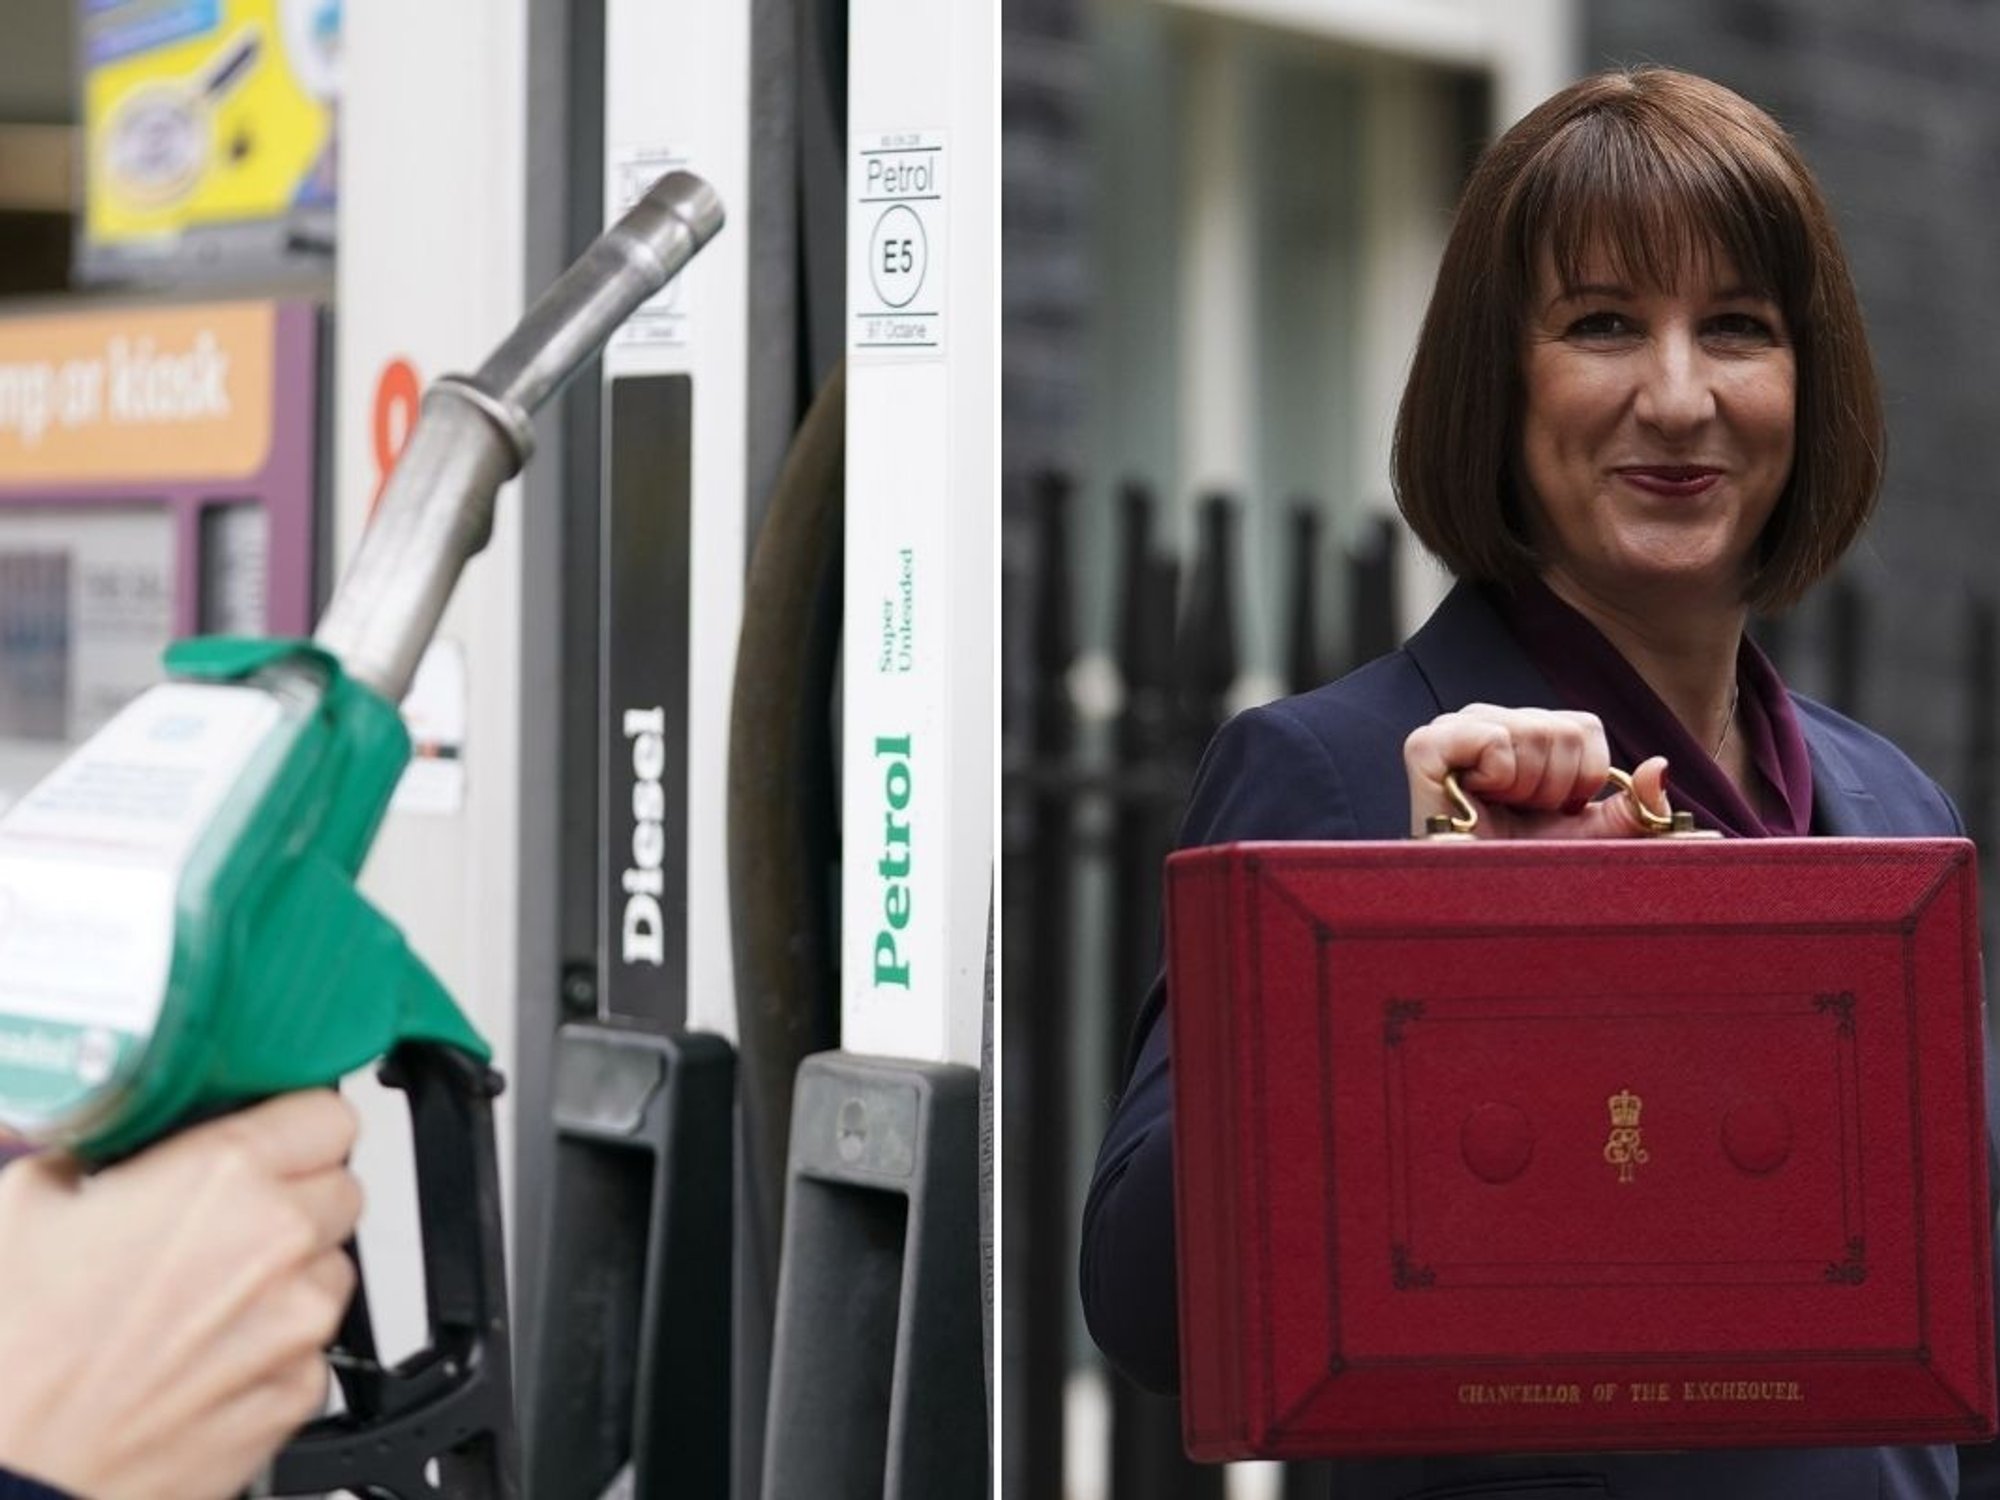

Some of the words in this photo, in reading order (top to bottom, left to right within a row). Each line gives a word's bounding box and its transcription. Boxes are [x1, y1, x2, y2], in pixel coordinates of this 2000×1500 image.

[867, 155, 934, 194] Petrol
[883, 239, 913, 274] E5
[106, 328, 231, 427] kiosk
[880, 599, 896, 673] Super
[898, 548, 913, 673] Unleaded
[622, 706, 665, 965] Diesel
[874, 734, 912, 990] Petrol
[1457, 1384, 1581, 1404] CHANCELLOR
[1593, 1383, 1618, 1403] OF
[1630, 1382, 1670, 1402] THE
